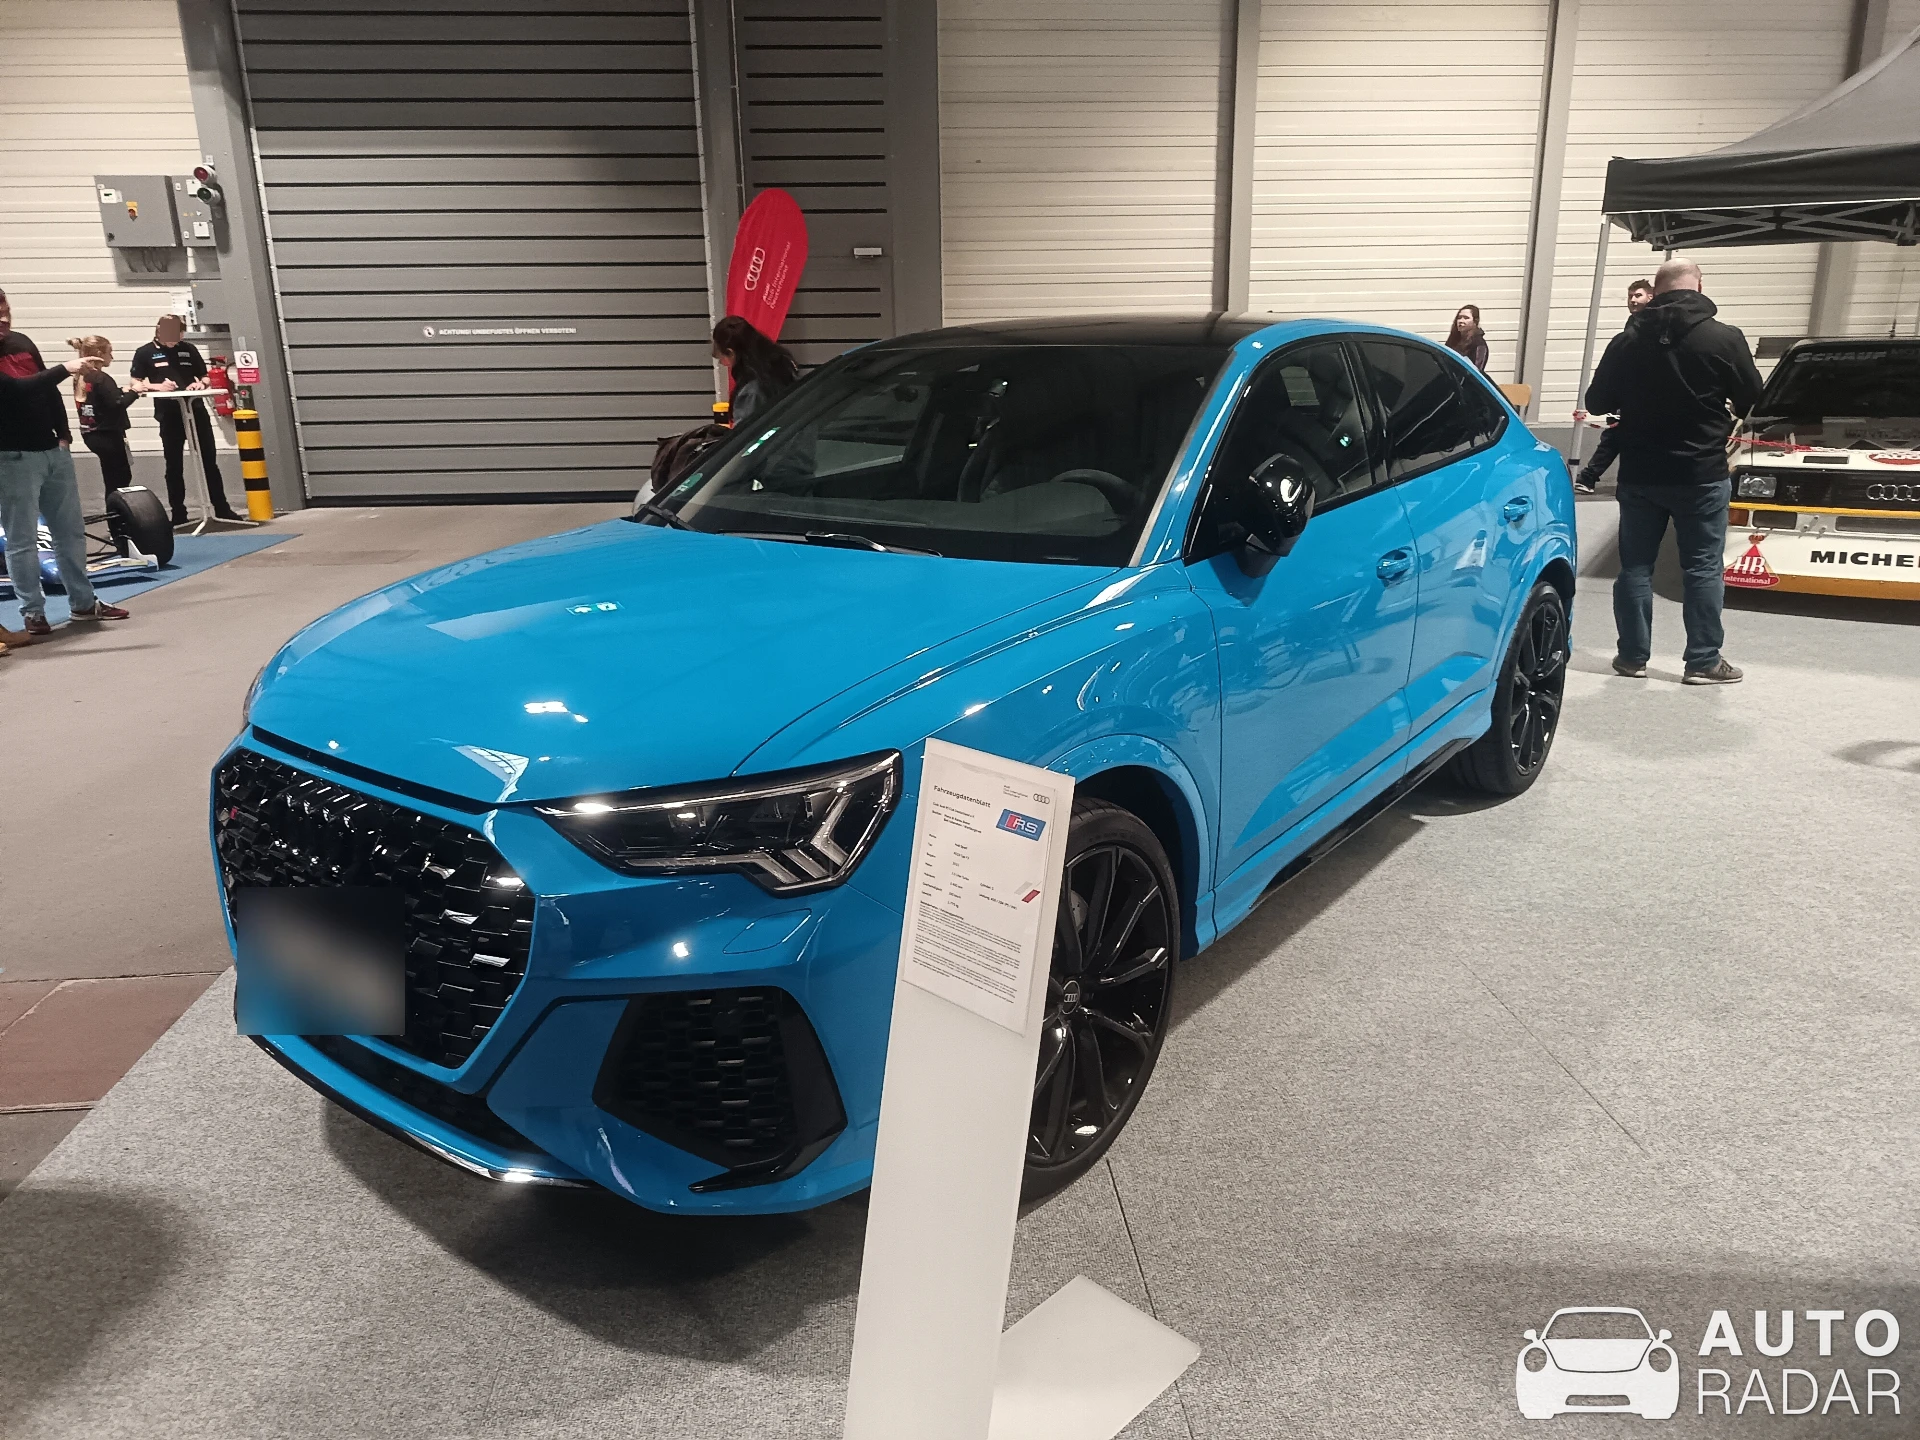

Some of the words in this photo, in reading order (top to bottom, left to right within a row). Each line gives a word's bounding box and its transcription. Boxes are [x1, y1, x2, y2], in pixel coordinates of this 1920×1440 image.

[1733, 556, 1766, 576] HB
[1810, 550, 1920, 569] MICHE
[1723, 575, 1771, 585] international
[934, 785, 991, 808] Fahrzeugdatenblatt
[1012, 816, 1038, 834] RS
